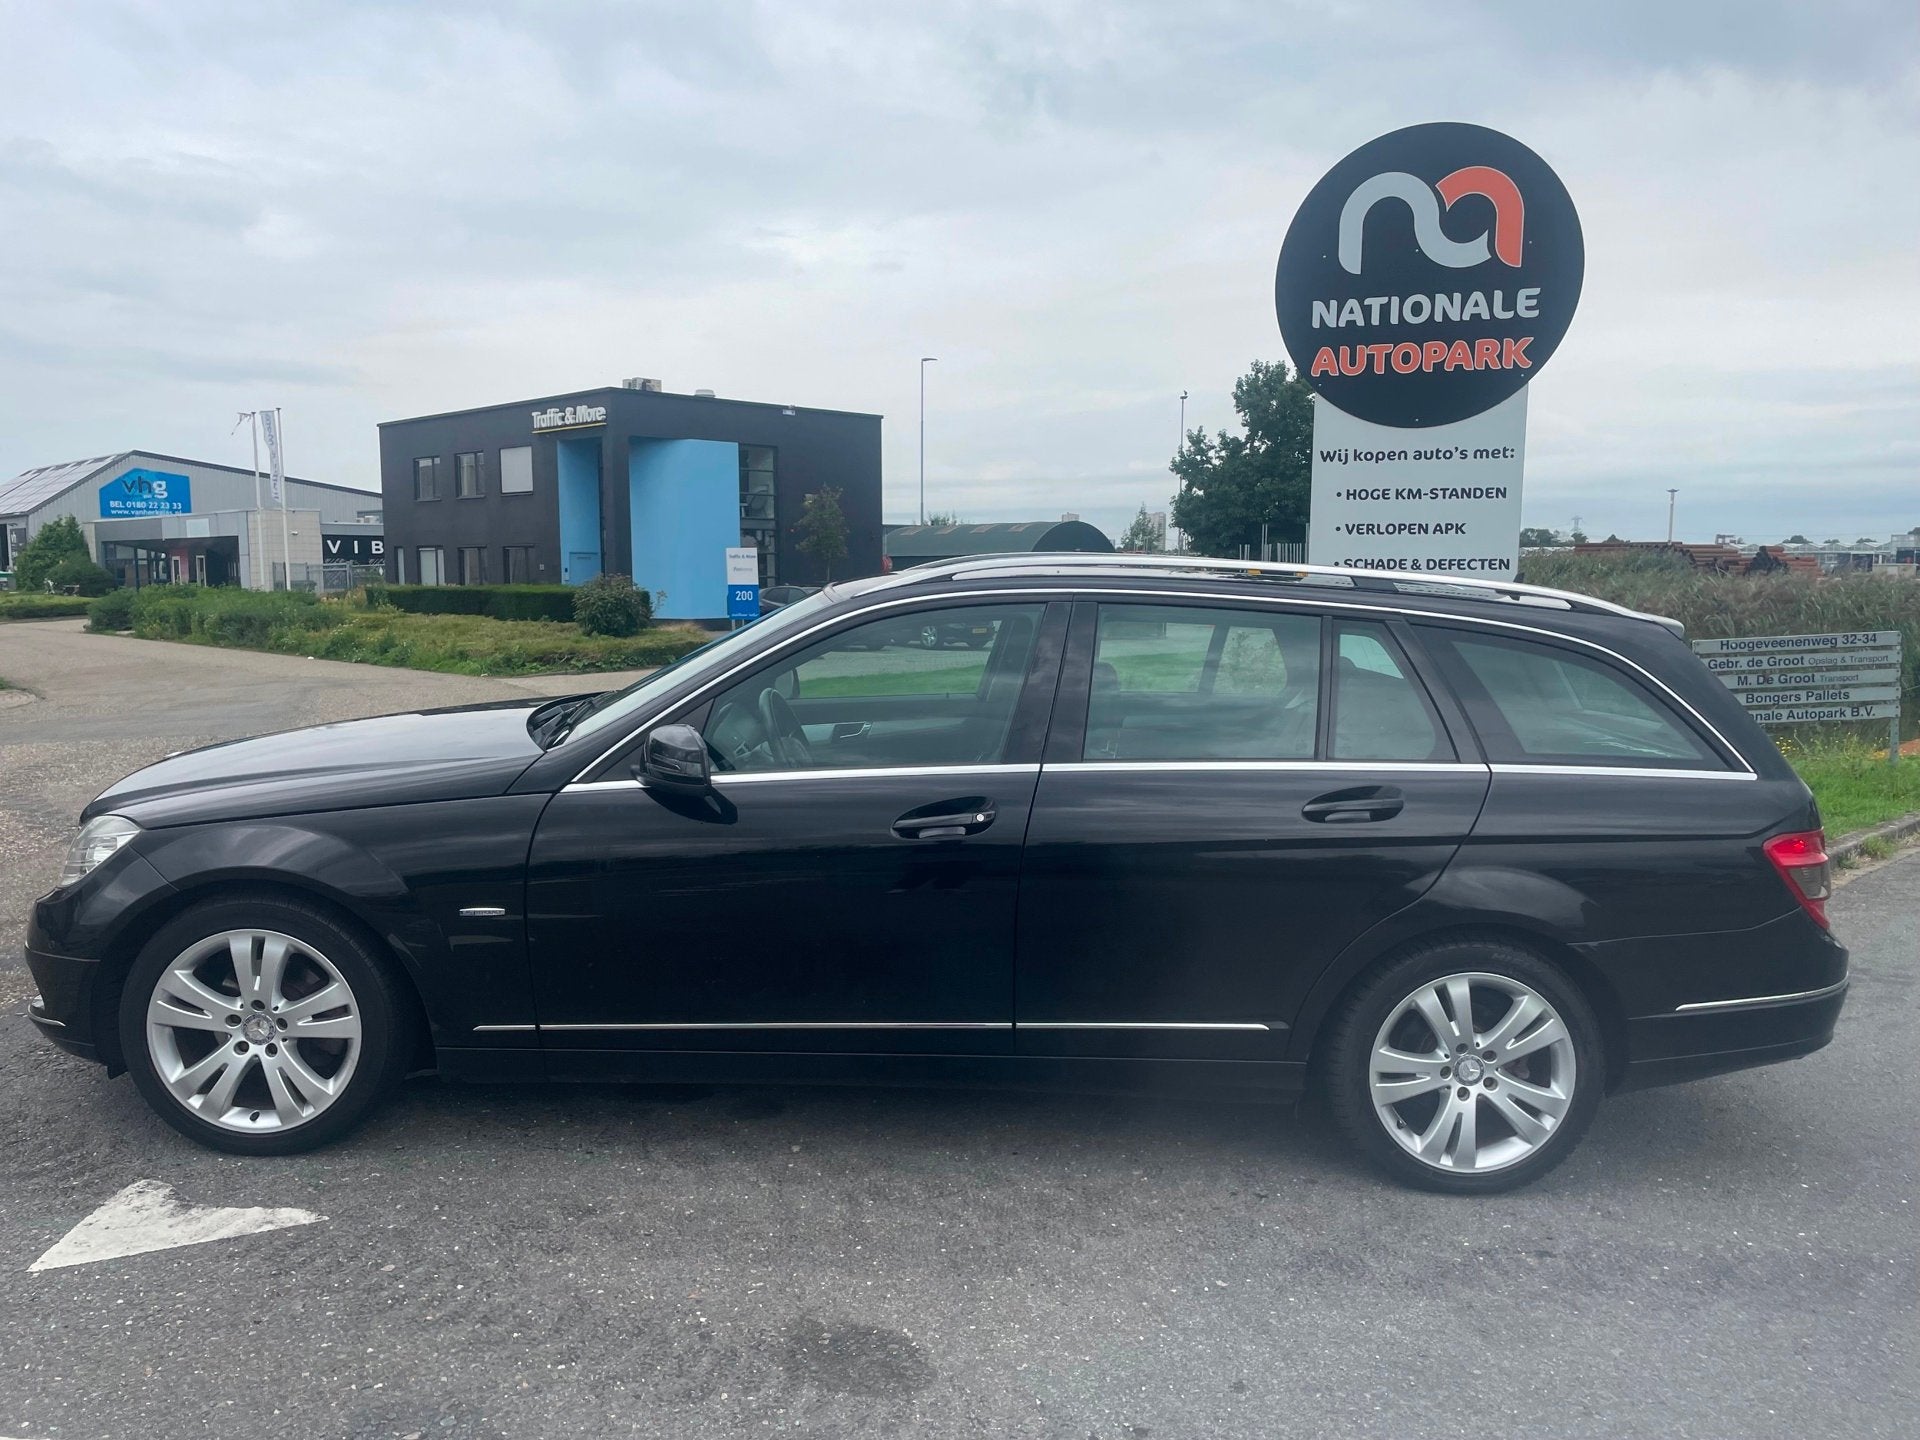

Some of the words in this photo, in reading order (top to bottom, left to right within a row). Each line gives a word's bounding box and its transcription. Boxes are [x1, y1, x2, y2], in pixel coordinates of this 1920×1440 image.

[1311, 287, 1541, 329] NATIONALE
[1310, 337, 1534, 377] AUTOPARK
[531, 407, 565, 429] Traffic
[565, 406, 576, 425] &
[576, 404, 607, 423] More
[1320, 450, 1349, 465] Wij
[1353, 448, 1408, 464] kopen
[1413, 446, 1468, 461] auto's
[1473, 446, 1515, 460] met:
[121, 475, 168, 499] vhg
[1346, 488, 1391, 501] HOGE
[1395, 486, 1507, 500] KM-STANDEN
[110, 500, 125, 509] BEL
[126, 501, 147, 509] 0180
[148, 502, 159, 510] 22
[160, 502, 170, 510] 23
[1345, 523, 1429, 535] VERLOPEN
[1433, 523, 1466, 535] APK
[1343, 558, 1408, 570] SCHADE
[1410, 558, 1422, 570] &
[1426, 558, 1510, 570] DEFECTEN
[735, 591, 753, 601] 200
[1720, 636, 1838, 651] Hoogeveenenweg
[1841, 633, 1877, 645] 32-34
[1708, 658, 1743, 670] Gebr.
[1746, 657, 1763, 668] de
[1767, 655, 1805, 667] Groot
[1808, 657, 1838, 666] Opslag
[1849, 655, 1889, 663] Transport
[1737, 675, 1752, 686] M.
[1756, 674, 1774, 685] De
[1778, 673, 1815, 685] Groot
[1819, 674, 1859, 682] Transport
[1745, 692, 1801, 705] Bongers
[1806, 690, 1850, 701] Pallets
[1786, 707, 1847, 720] Autopark
[1851, 705, 1876, 717] B.V.
